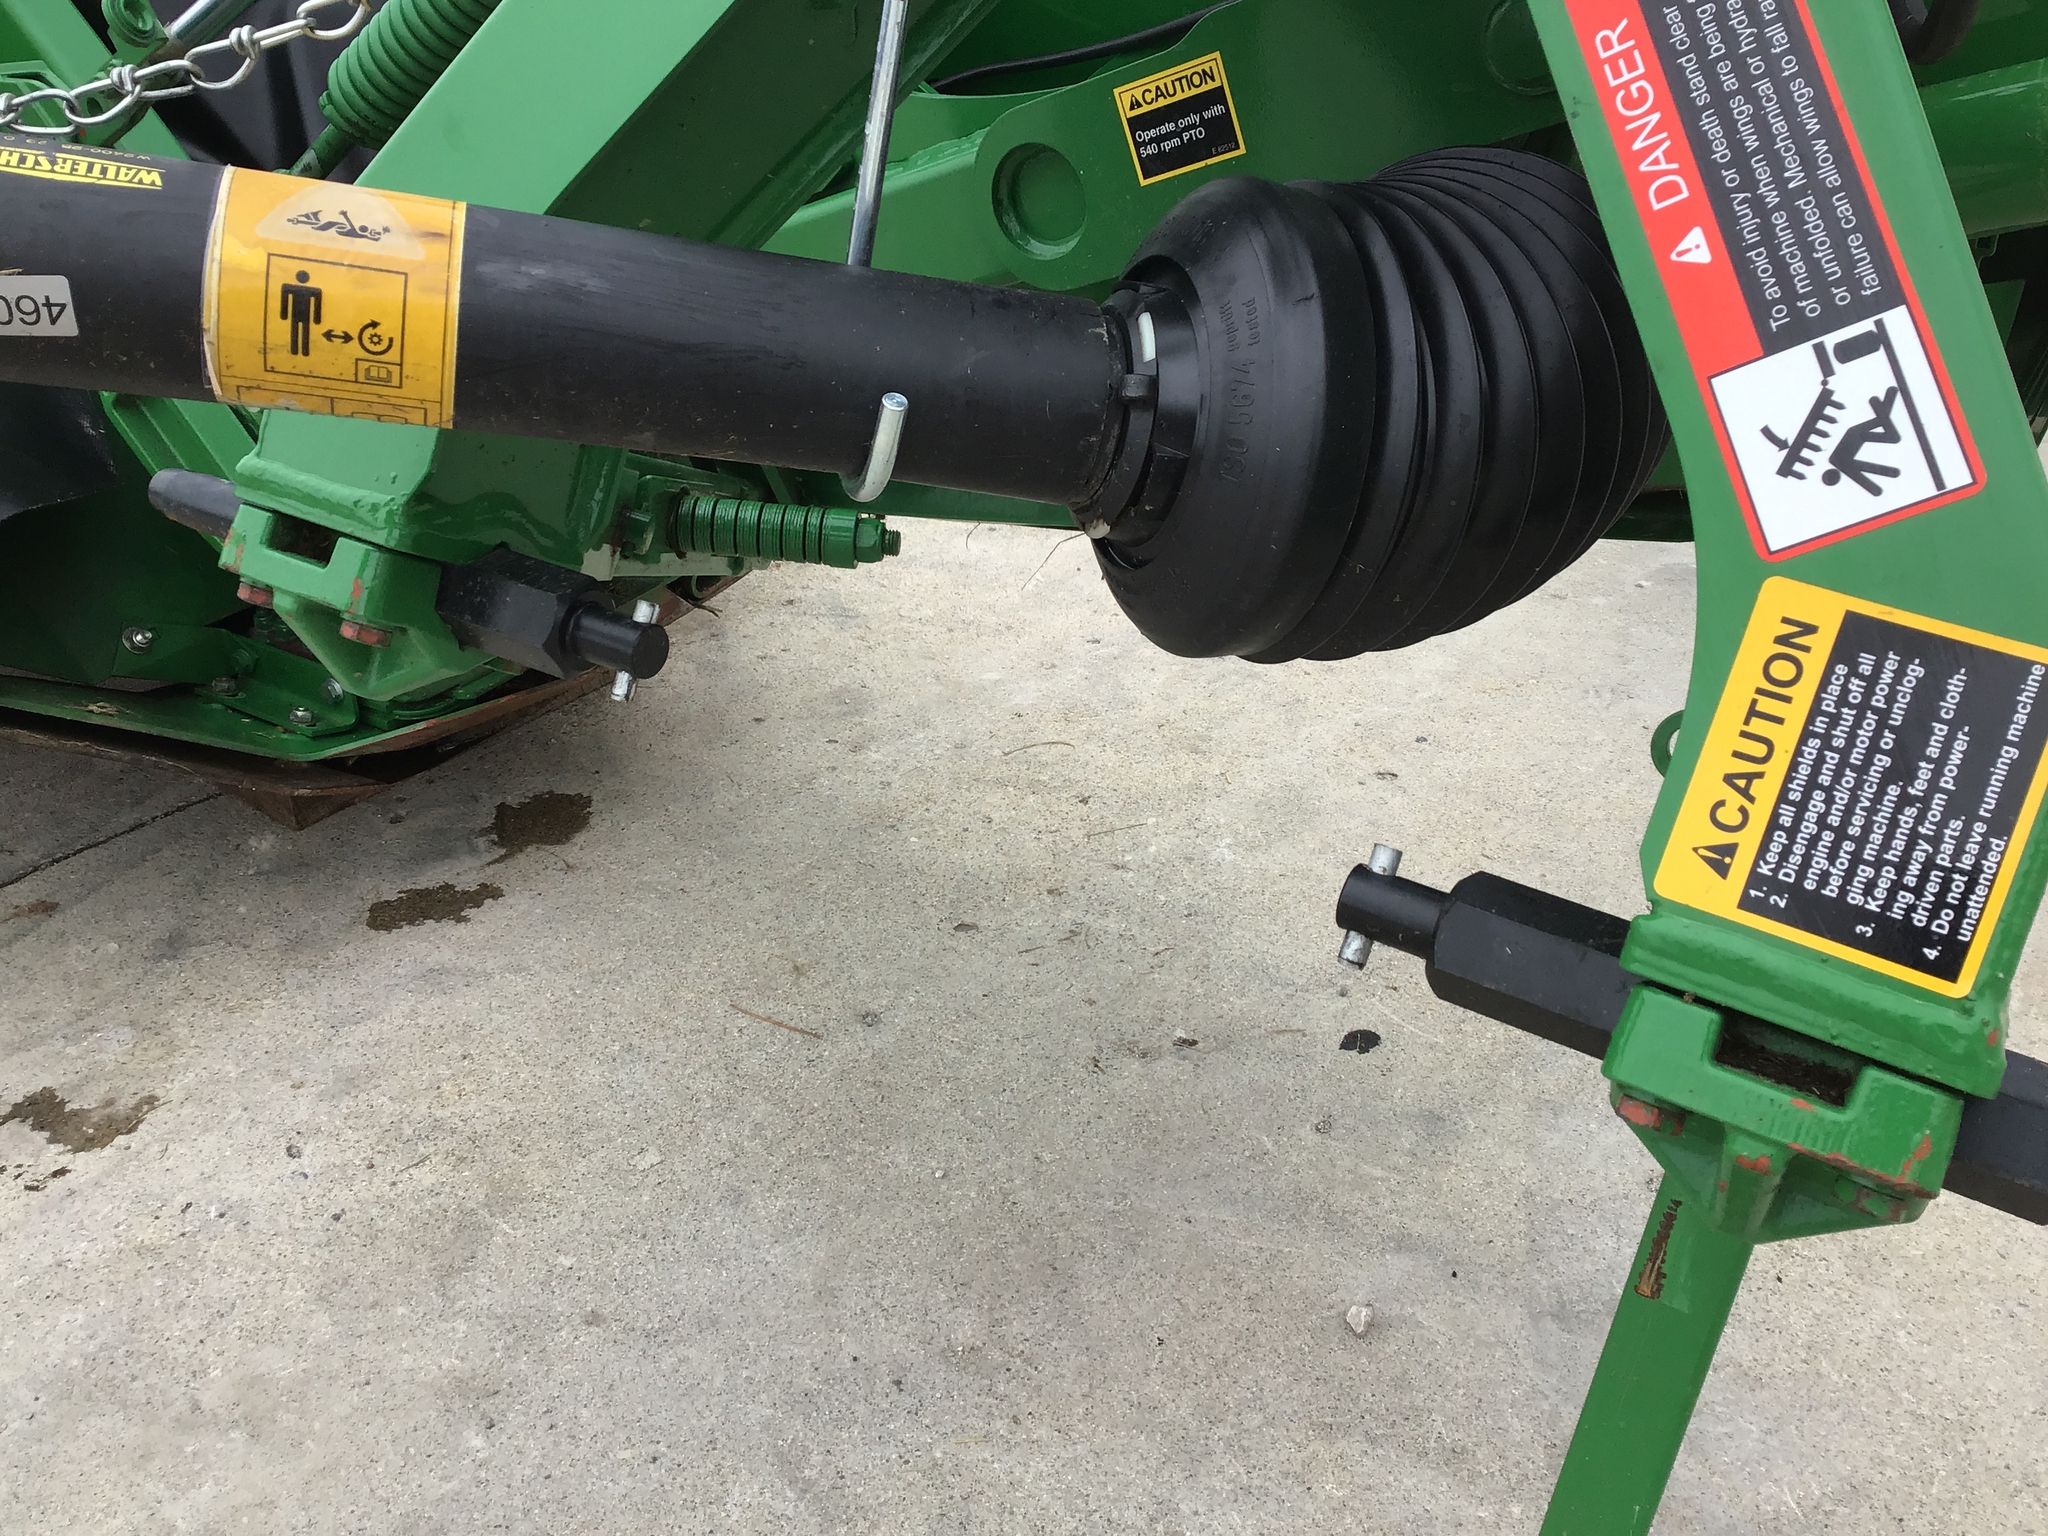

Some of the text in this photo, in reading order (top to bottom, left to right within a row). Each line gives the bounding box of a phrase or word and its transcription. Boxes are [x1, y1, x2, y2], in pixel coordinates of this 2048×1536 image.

[1141, 65, 1216, 106] CAUTION
[1745, 55, 1765, 74] or
[1763, 21, 1790, 53] fall
[1780, 54, 1799, 76] to
[1135, 103, 1226, 143] Operate only with
[1139, 126, 1206, 158] 540 rpm PTO
[1594, 17, 1690, 211] DANGER
[1695, 2, 1821, 317] of machine when wings are being
[1750, 77, 1807, 189] Mechanical
[1789, 77, 1821, 136] wings
[1662, 5, 1790, 332] To avoid injury or death stand clear
[1810, 138, 1841, 188] allow
[1831, 191, 1856, 228] can
[1793, 189, 1842, 281] unfolded.
[1847, 232, 1881, 295] failure
[1830, 285, 1851, 305] or
[1228, 360, 1256, 426] 5674
[1708, 615, 1820, 833] CAUTION
[1802, 650, 1901, 890] engine and/or motor power
[1820, 657, 1925, 898] before servicing or unclog-
[1748, 663, 1848, 897] 1. Keep all shields in place
[1768, 652, 1877, 908] 2. Disengage and shut off all
[1854, 667, 1967, 937] 3. Keep hands, feet and cloth-
[1885, 725, 1970, 920] ing away from power-
[1922, 663, 2046, 960] 4. Do not leave running machine
[1845, 781, 1903, 906] ging machine.
[1910, 815, 1966, 927] driven parts.
[1956, 835, 2008, 941] unattended.
